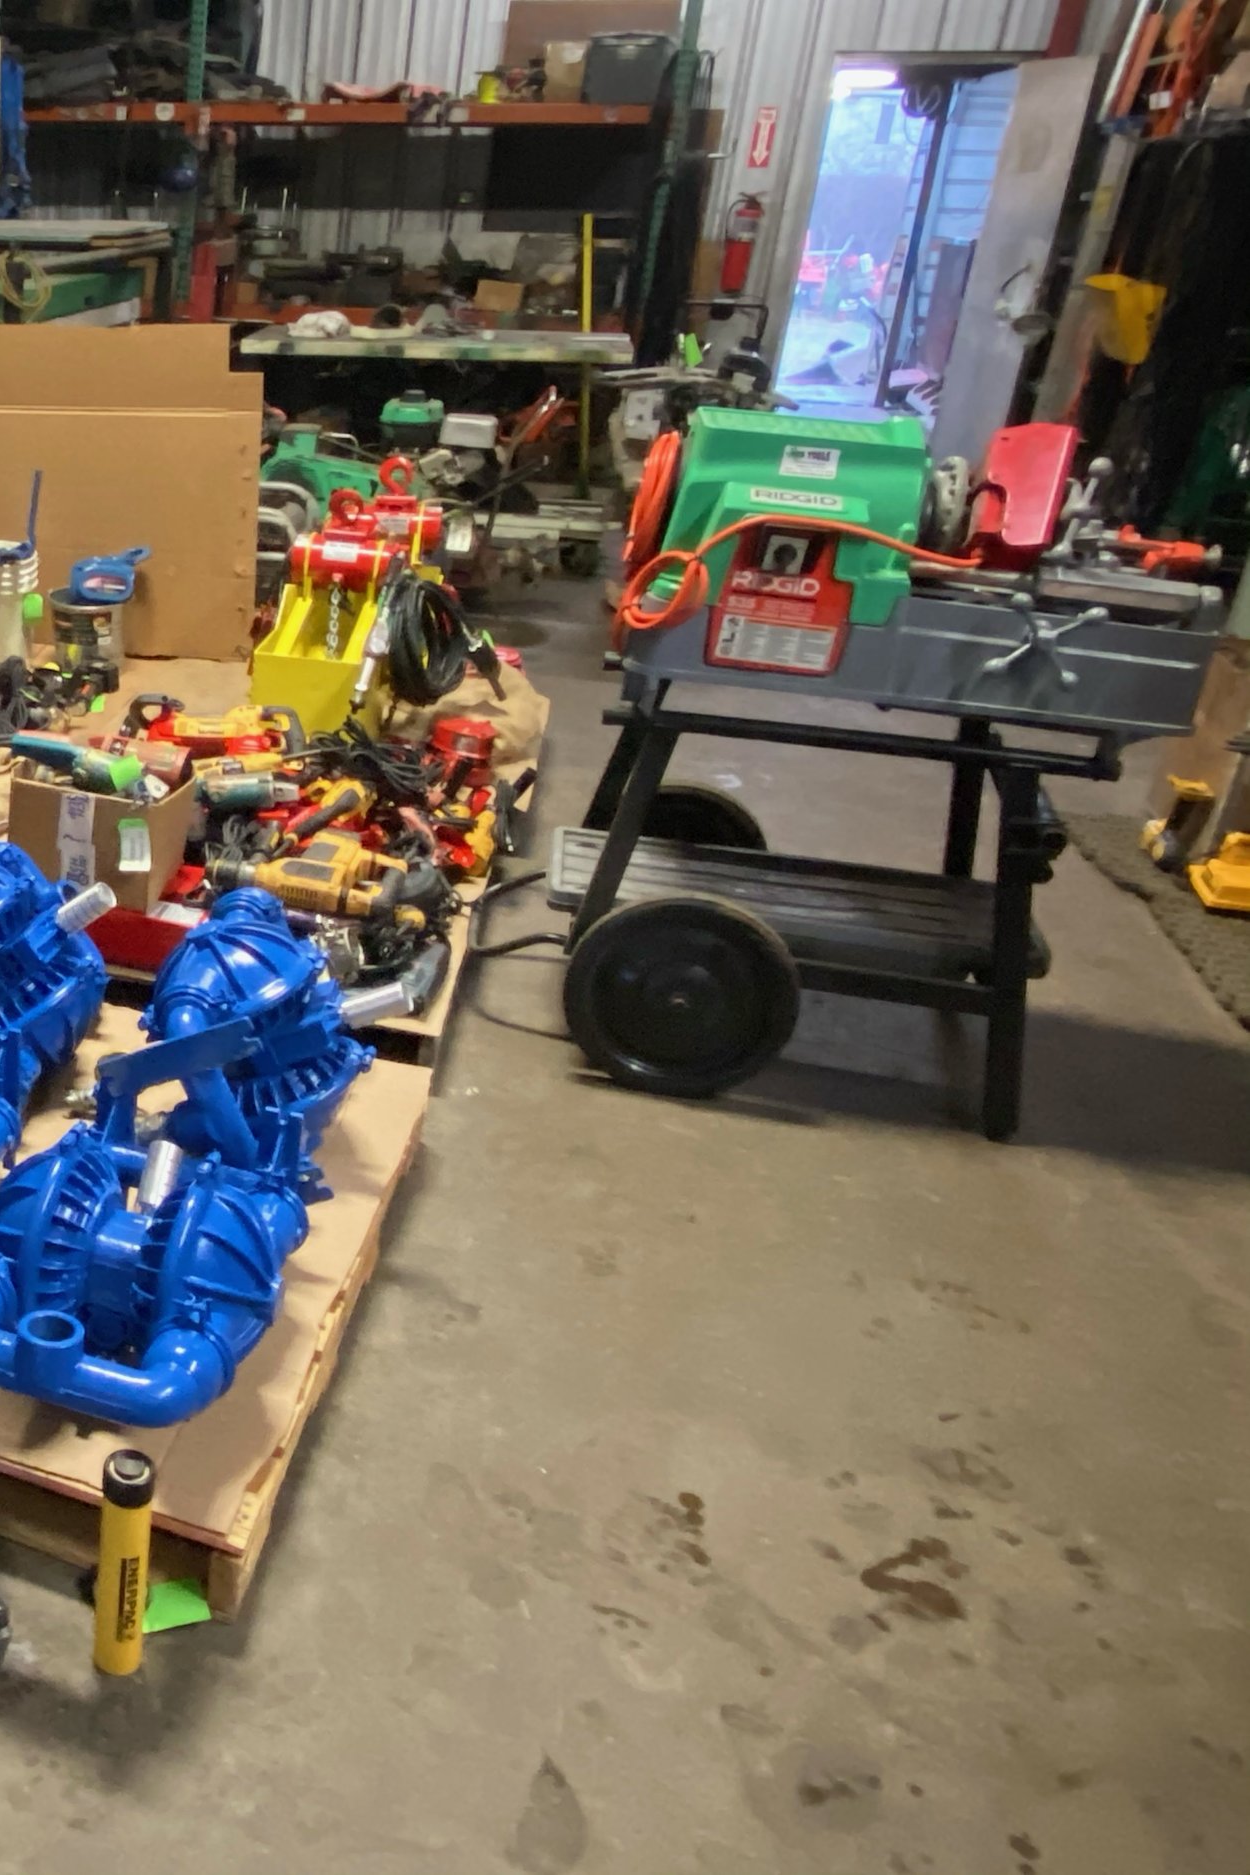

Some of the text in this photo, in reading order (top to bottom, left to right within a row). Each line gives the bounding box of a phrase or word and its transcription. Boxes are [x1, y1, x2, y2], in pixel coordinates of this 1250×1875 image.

[754, 488, 838, 507] RIDGID
[731, 571, 820, 597] RIDGID
[125, 1556, 140, 1630] ENERPAC
